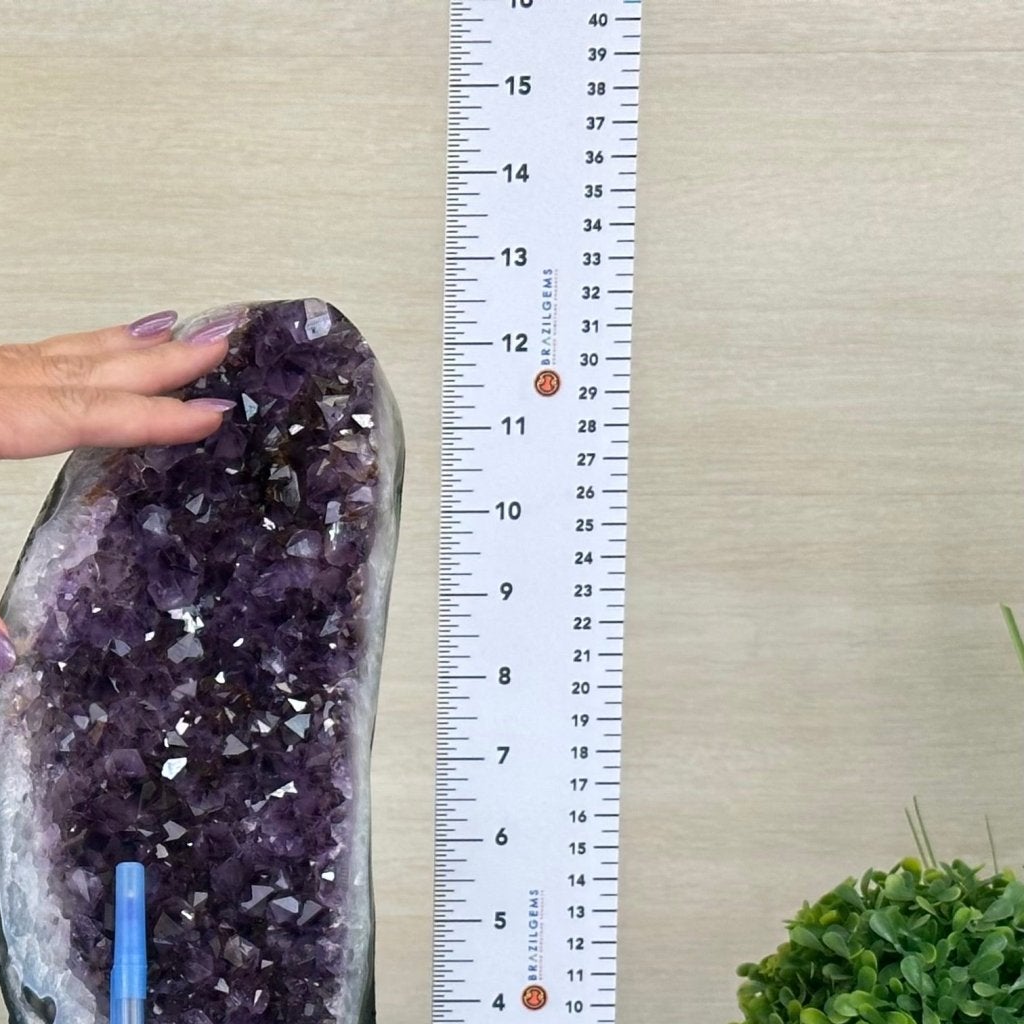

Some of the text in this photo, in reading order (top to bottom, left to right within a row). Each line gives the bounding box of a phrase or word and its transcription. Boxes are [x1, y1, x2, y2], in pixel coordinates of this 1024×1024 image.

[589, 13, 607, 27] 40
[588, 48, 606, 61] 39
[505, 76, 531, 95] 15
[588, 82, 605, 95] 38
[587, 117, 605, 130] 37
[586, 151, 603, 164] 36
[503, 164, 529, 182] 14
[585, 185, 602, 198] 35
[584, 219, 602, 232] 34
[501, 248, 527, 266] 13
[583, 252, 600, 265] 33
[582, 286, 600, 299] 32
[582, 320, 598, 333] 31
[502, 333, 527, 352] 12
[580, 353, 598, 366] 30
[579, 387, 597, 399] 29
[502, 417, 524, 435] 11
[578, 420, 596, 433] 28
[577, 453, 595, 466] 27
[577, 486, 594, 499] 26
[496, 502, 521, 520] 10
[576, 519, 593, 531] 25
[575, 552, 593, 564] 24
[500, 582, 513, 600] 9
[574, 584, 592, 597] 23
[574, 617, 591, 630] 22
[574, 650, 590, 662] 21
[499, 667, 510, 685] 8
[572, 682, 590, 694] 20
[572, 714, 589, 726] 19
[497, 747, 509, 764] 7
[571, 746, 588, 759] 18
[571, 779, 587, 791] 17
[570, 811, 586, 823] 16
[495, 828, 508, 846] 6
[569, 842, 586, 854] 15
[568, 874, 585, 886] 14
[568, 906, 584, 918] 13
[494, 912, 506, 929] 5
[567, 938, 584, 950] 12
[567, 969, 583, 981] 11
[492, 993, 505, 1011] 4
[566, 1001, 583, 1013] 10
